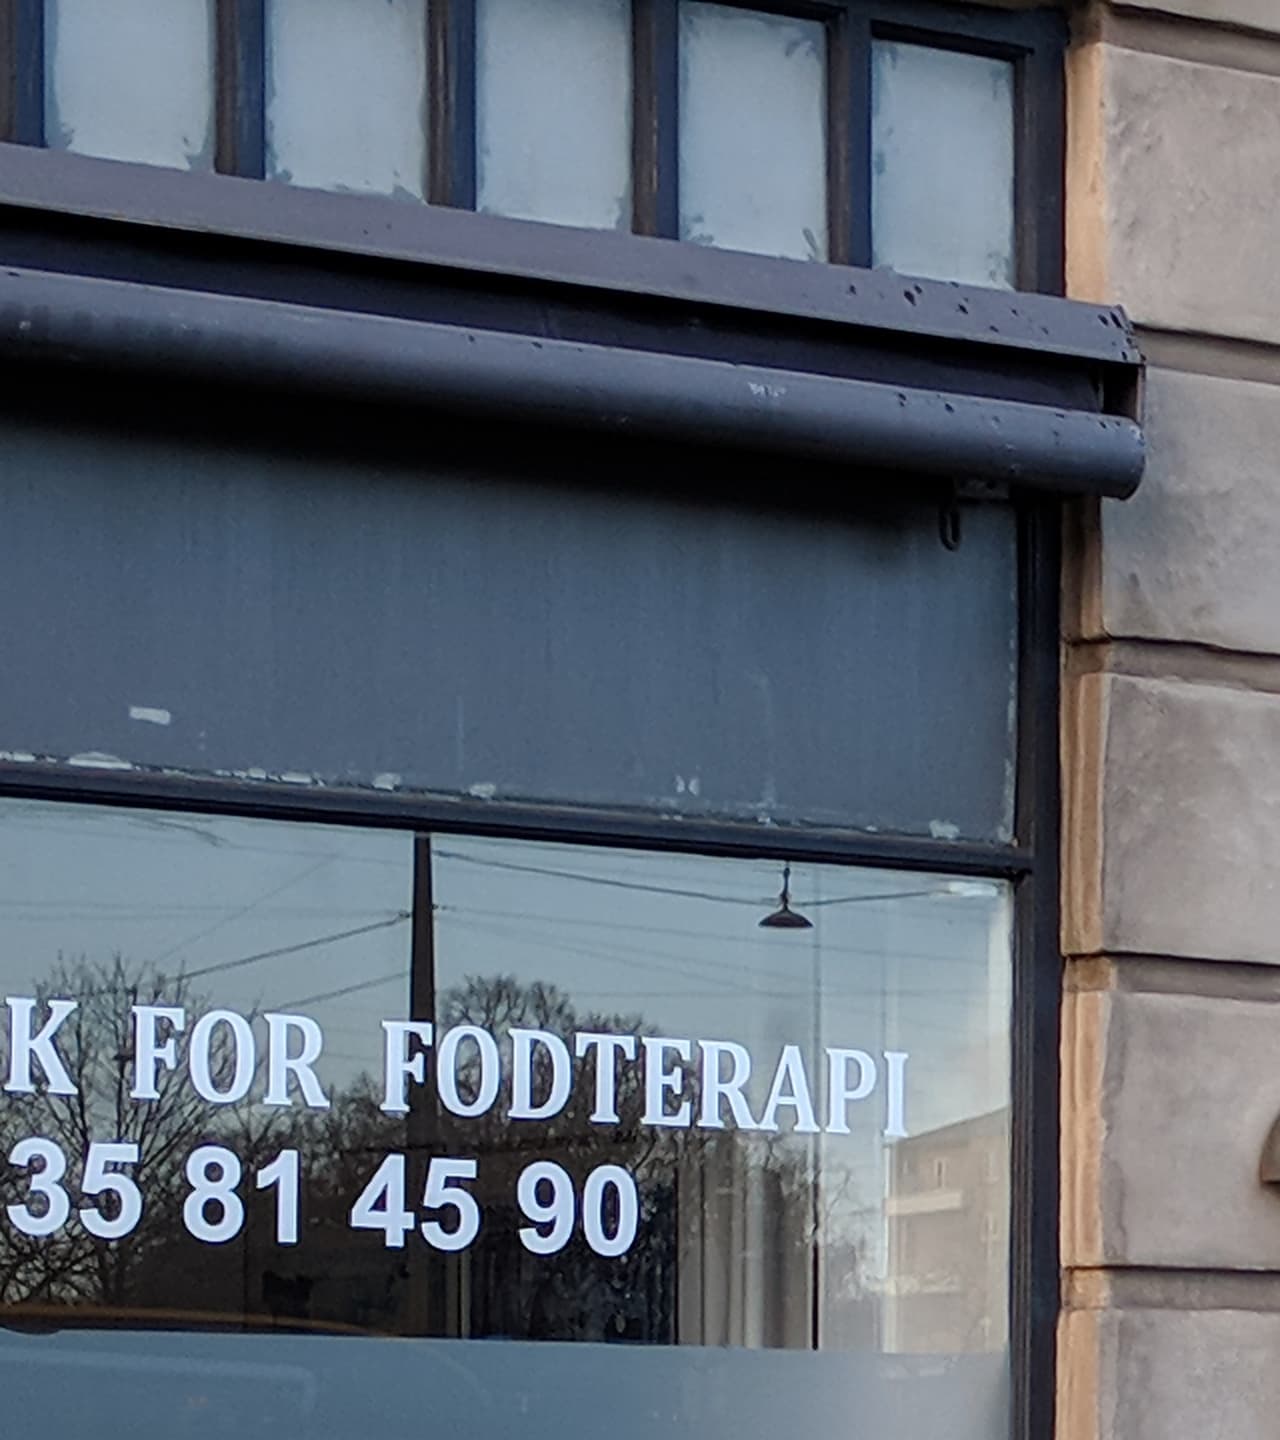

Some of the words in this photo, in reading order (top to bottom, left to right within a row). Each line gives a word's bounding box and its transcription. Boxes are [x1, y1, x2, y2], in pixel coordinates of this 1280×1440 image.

[4, 997, 78, 1095] K
[129, 1004, 330, 1109] FOR
[379, 1019, 910, 1139] FODTERAPI
[7, 1136, 142, 1239] 35
[183, 1145, 300, 1244] 81
[350, 1153, 480, 1251] 45
[516, 1160, 638, 1257] 90
